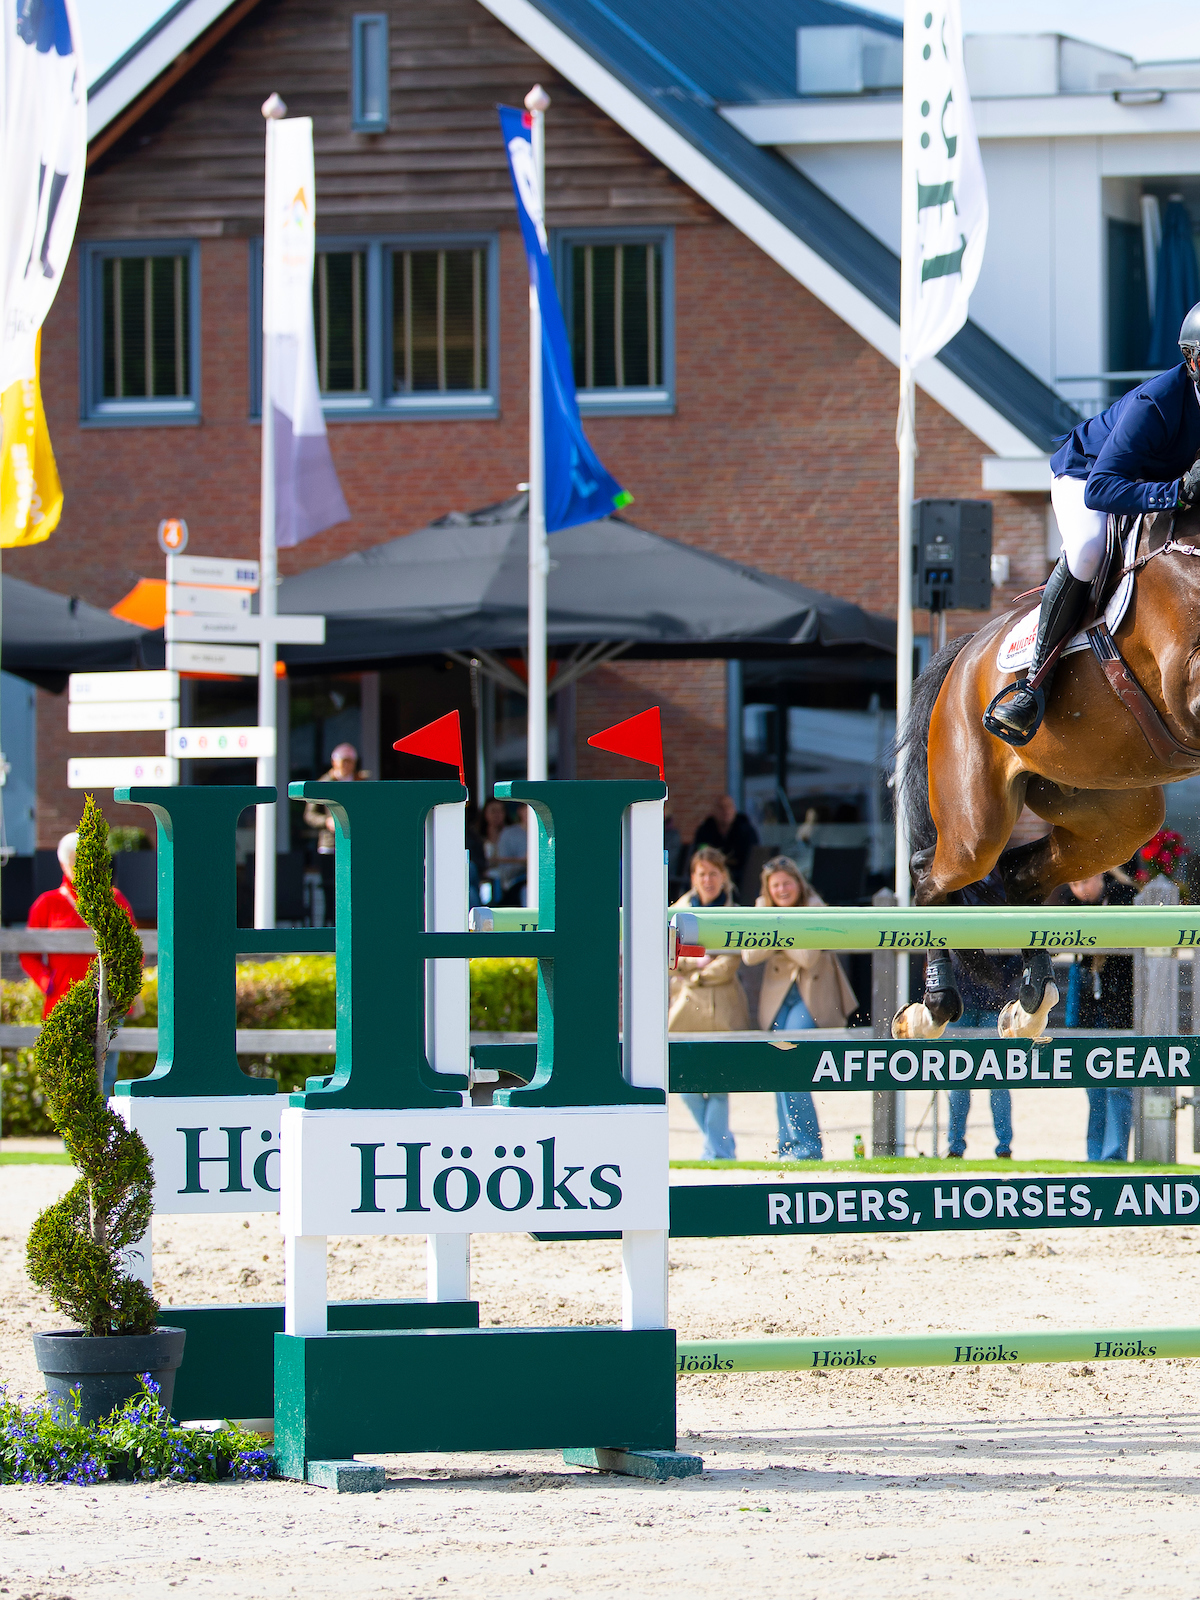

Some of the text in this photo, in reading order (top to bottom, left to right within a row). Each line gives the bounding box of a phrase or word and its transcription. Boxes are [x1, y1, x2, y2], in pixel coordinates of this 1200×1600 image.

[724, 930, 794, 947] Hööks
[878, 930, 947, 948] Hööks
[1029, 929, 1097, 946] Hööks
[812, 1046, 1074, 1084] AFFORDABLE
[1085, 1044, 1191, 1081] GEAR
[351, 1136, 623, 1213] Hööks
[768, 1187, 923, 1227] RIDERS,
[934, 1184, 1103, 1222] HORSES,
[1114, 1182, 1200, 1217] AND
[810, 1348, 877, 1367] Hööks
[953, 1344, 1019, 1362] Hööks
[1094, 1339, 1157, 1357] Hööks
